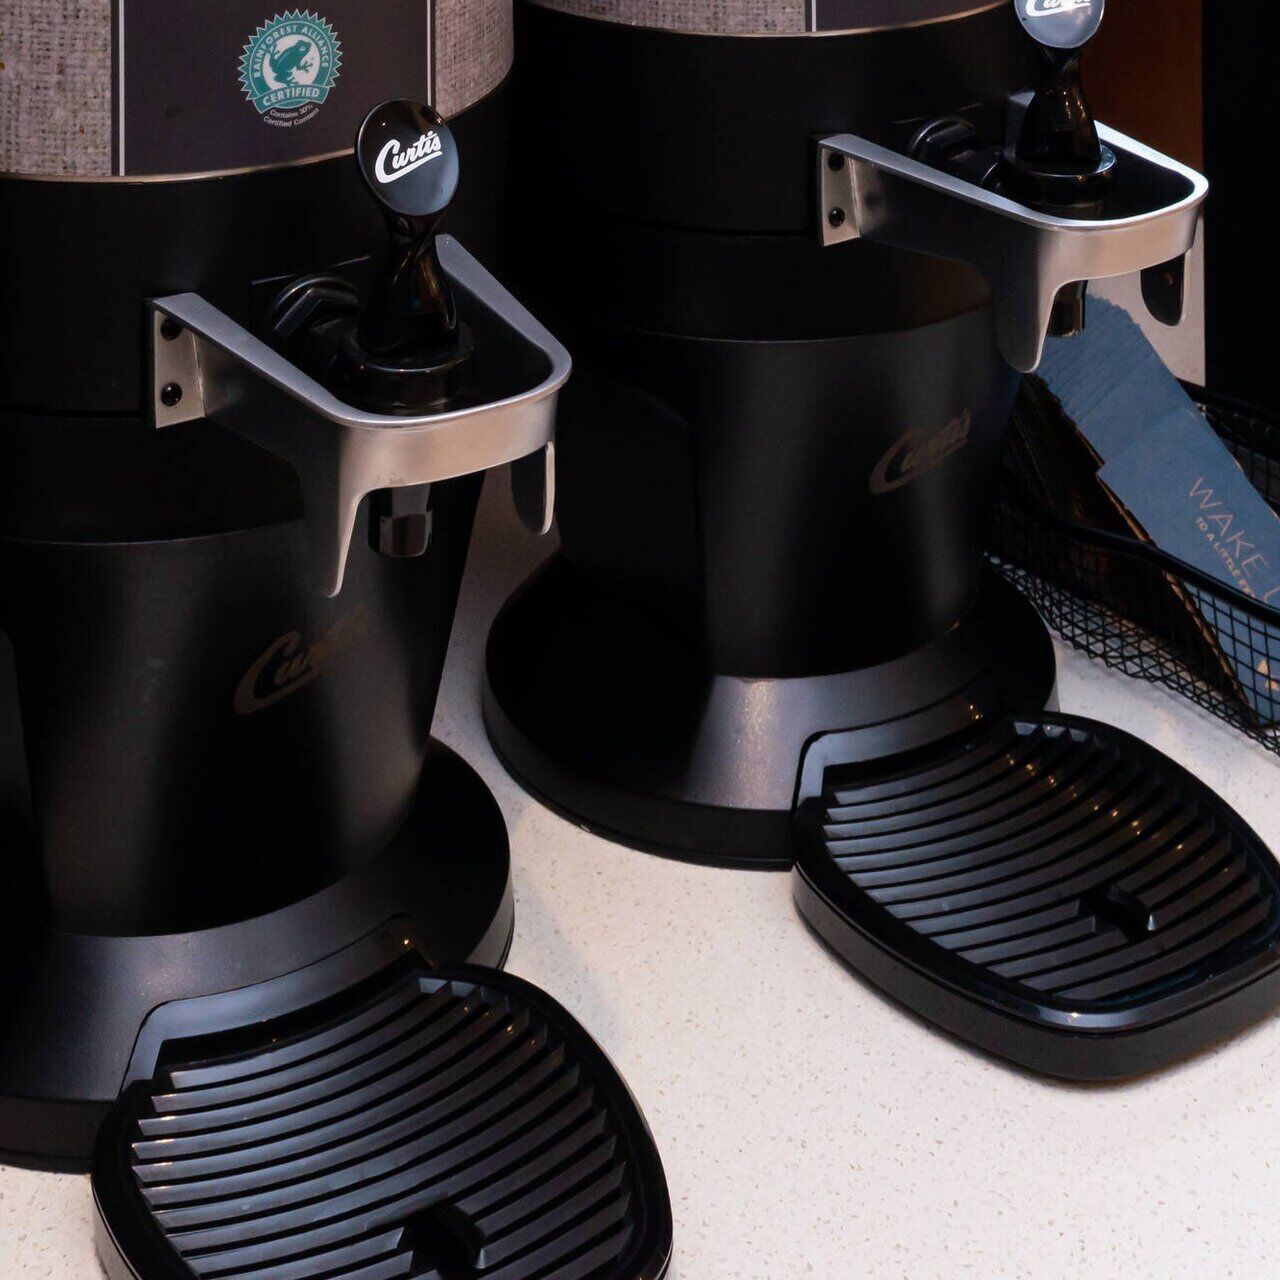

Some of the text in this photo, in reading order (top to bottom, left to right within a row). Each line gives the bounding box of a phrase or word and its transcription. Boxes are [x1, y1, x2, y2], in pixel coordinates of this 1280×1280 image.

[254, 24, 329, 78] RAINFOREST ALLIANCE
[262, 87, 320, 106] CERTIFIED
[374, 130, 443, 184] Curtis
[1190, 477, 1269, 578] WAKE
[1195, 516, 1209, 531] TO
[1214, 541, 1241, 577] LITTLE
